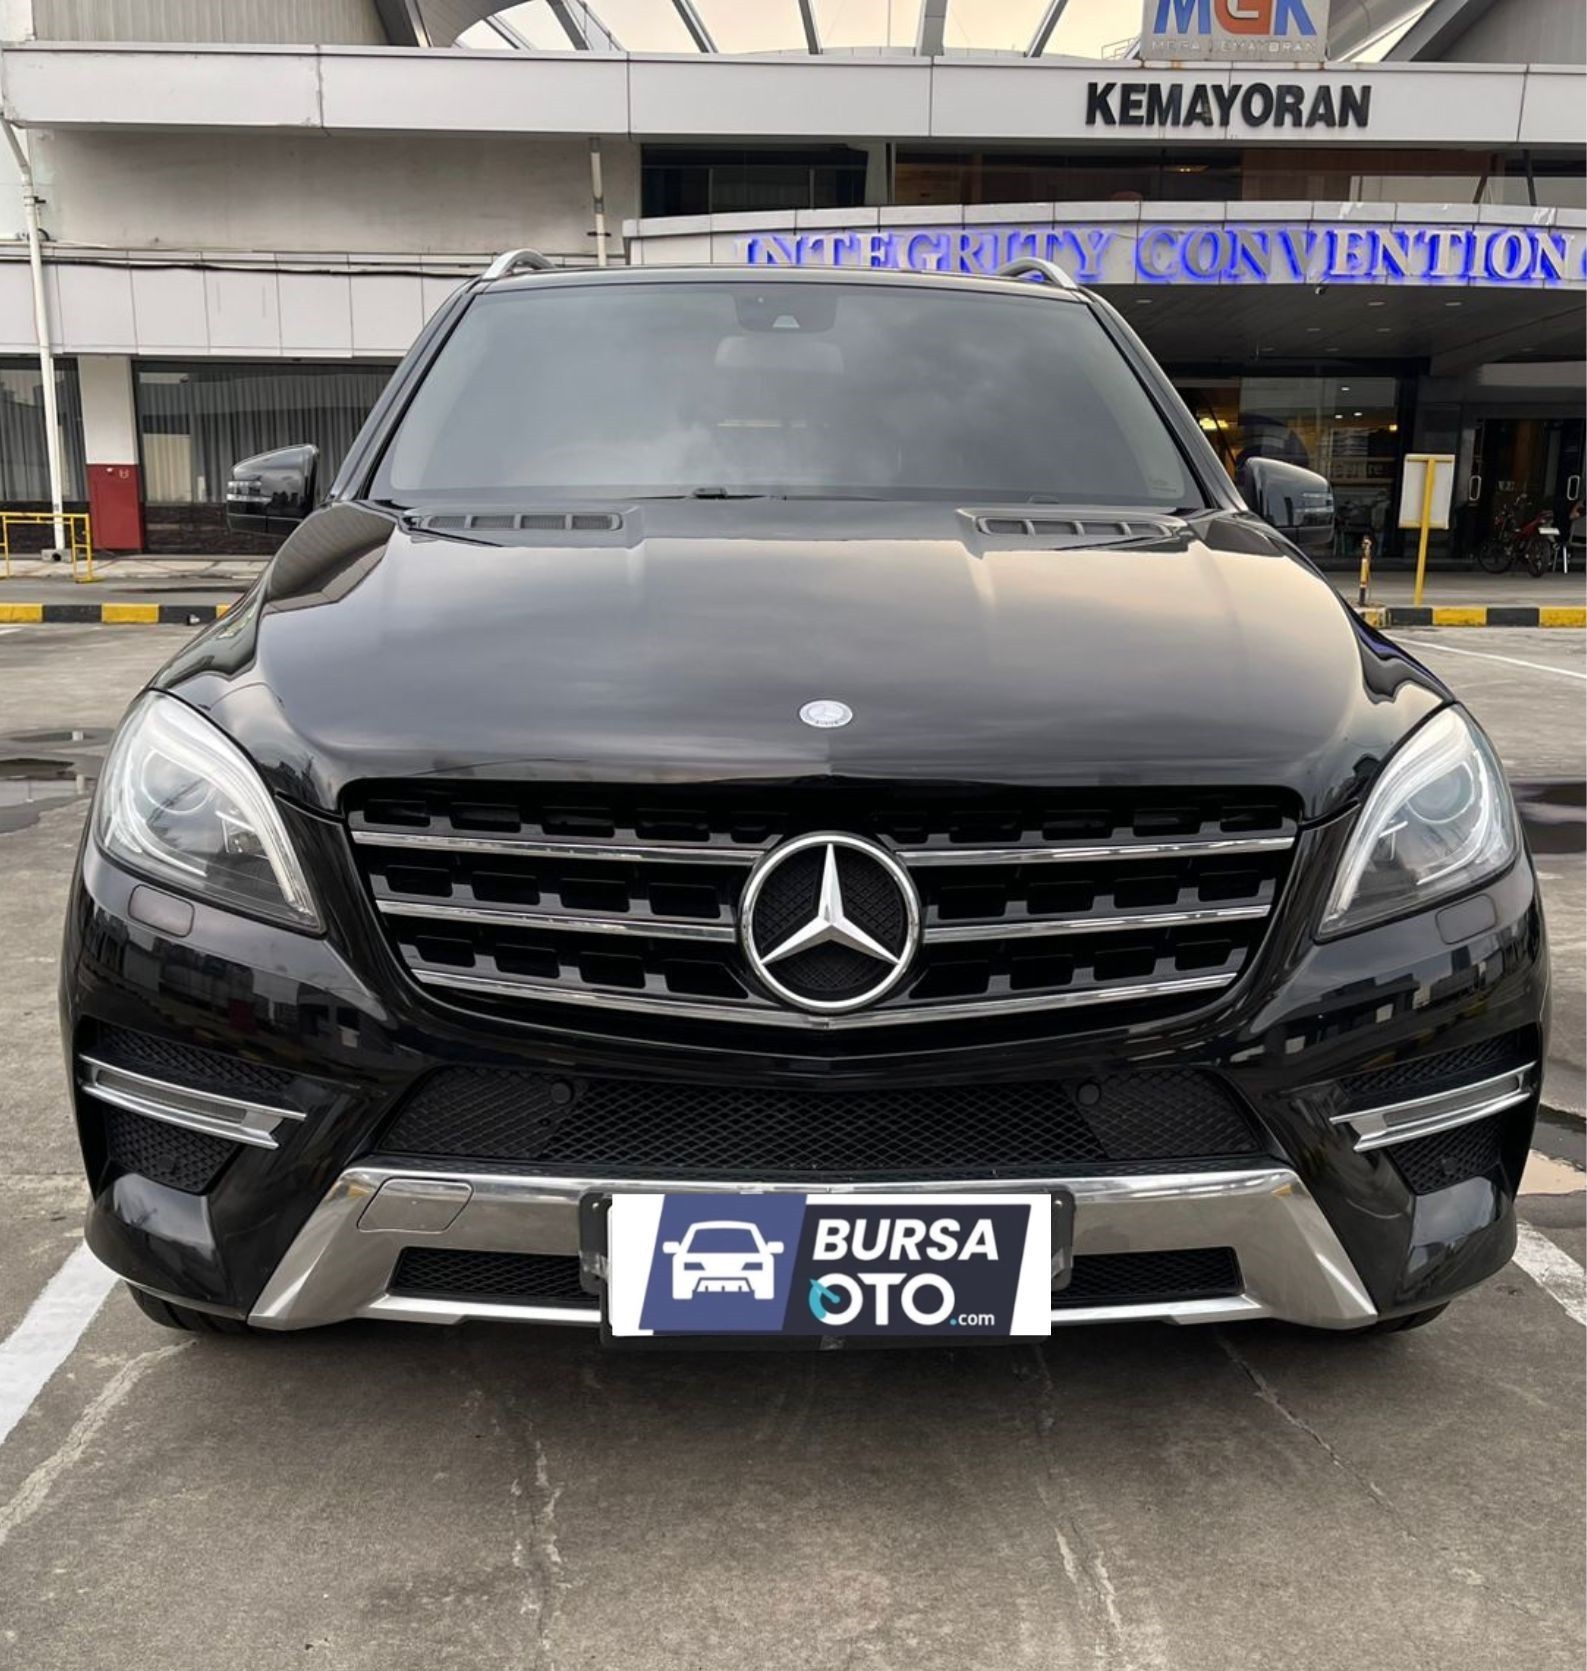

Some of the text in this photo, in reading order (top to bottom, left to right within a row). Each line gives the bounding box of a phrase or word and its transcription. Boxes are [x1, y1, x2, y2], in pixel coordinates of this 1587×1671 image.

[1085, 82, 1372, 128] KEMAYORAN
[736, 228, 1110, 278] INTEGRITY
[1136, 227, 1576, 280] CONVENTION
